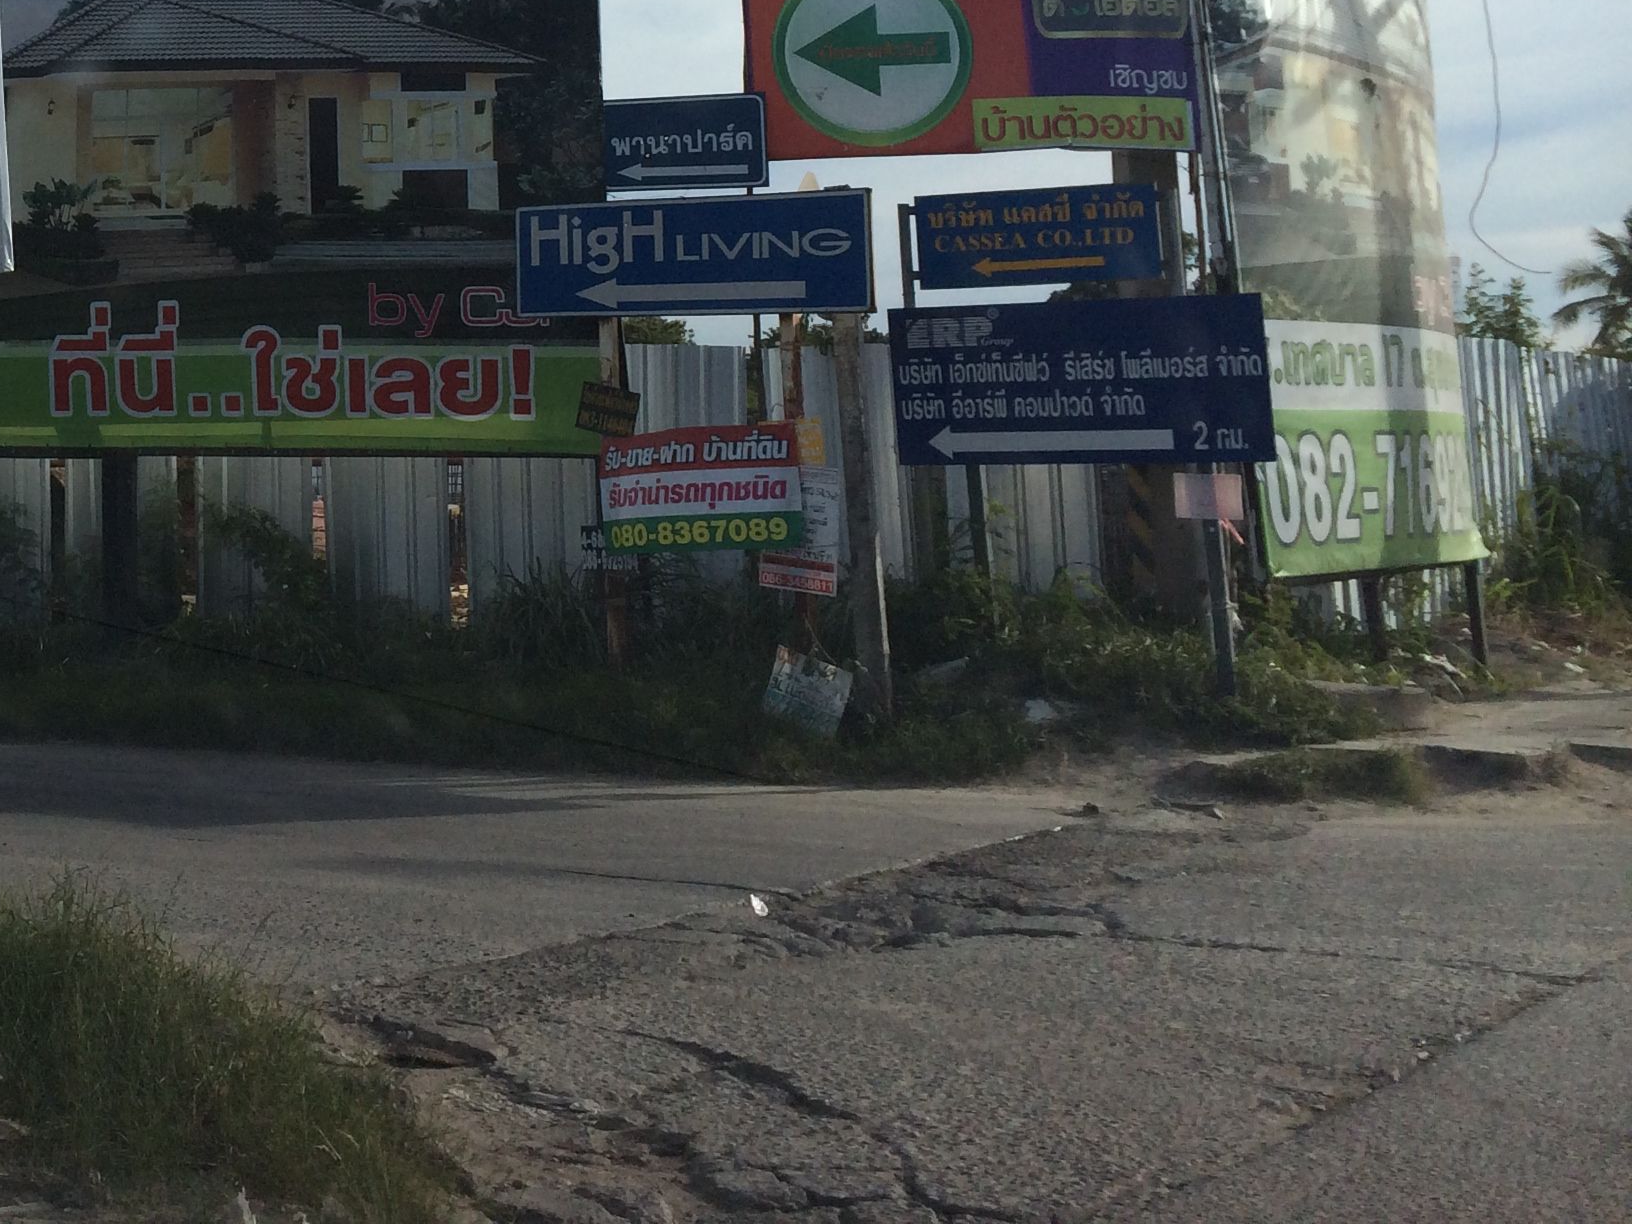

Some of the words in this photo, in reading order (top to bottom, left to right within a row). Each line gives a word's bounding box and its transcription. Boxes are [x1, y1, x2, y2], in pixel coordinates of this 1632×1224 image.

[1108, 63, 1188, 94] เชิญชม
[610, 123, 754, 157] พานาปาร์ค
[980, 104, 1185, 142] บ้านตัวอย่าง
[675, 227, 853, 262] LIVING
[933, 231, 1026, 252] CASSEA
[367, 282, 444, 337] by
[898, 357, 944, 385] บริษัท
[1215, 345, 1264, 377] จำกัด
[901, 392, 945, 421] บริษัท
[1100, 387, 1146, 416] จำกัด
[702, 430, 788, 463] บ้านที่ดิน
[1192, 420, 1209, 451] 2
[608, 474, 787, 510] รับจำนำรถทุกชนิด
[610, 516, 788, 549] 080-8367089
